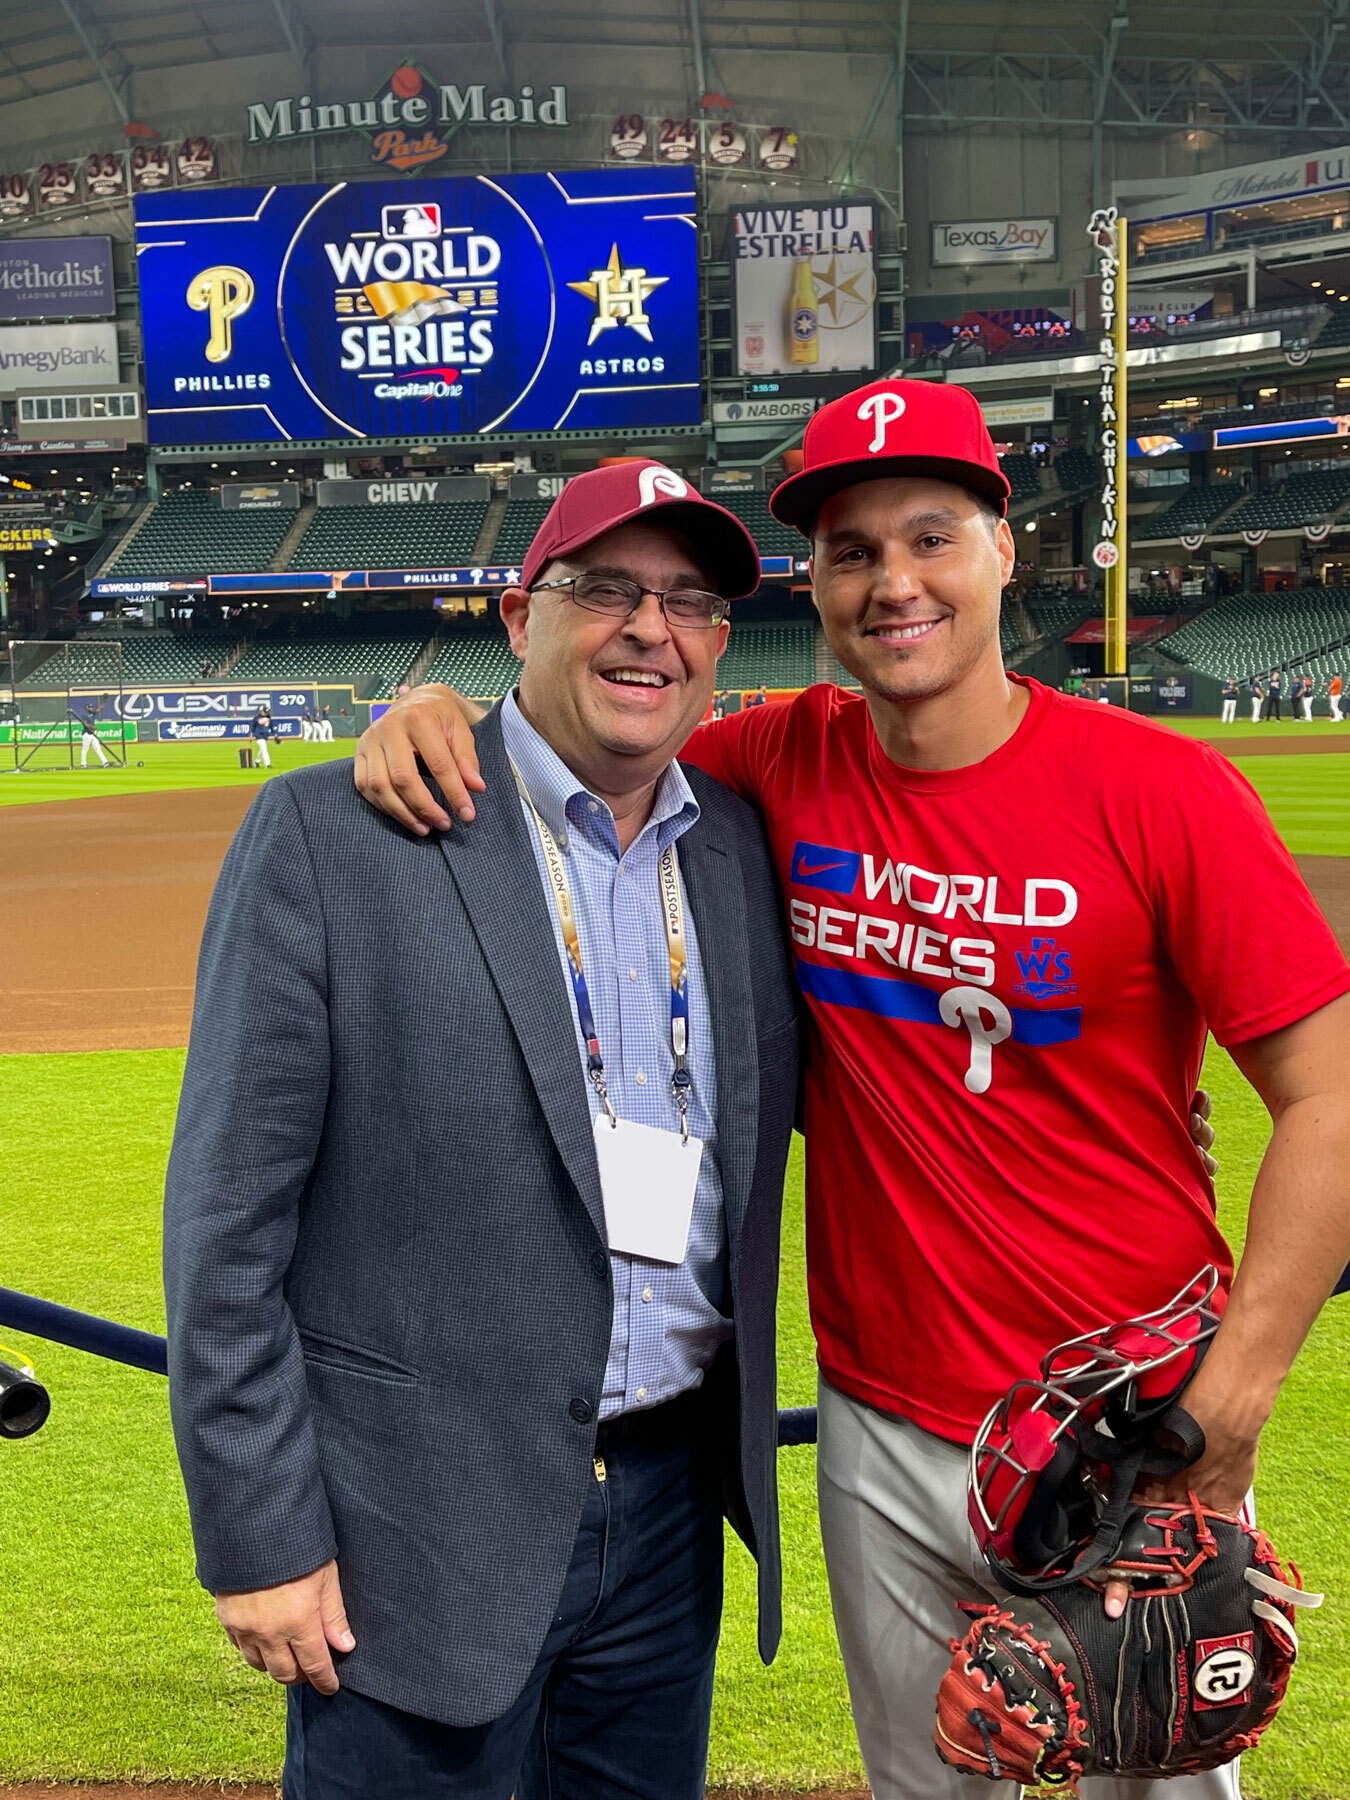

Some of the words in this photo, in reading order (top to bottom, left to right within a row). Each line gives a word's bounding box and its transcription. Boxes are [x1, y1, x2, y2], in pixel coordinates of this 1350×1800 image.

[247, 91, 429, 141] Minute
[439, 85, 569, 125] Maid
[612, 114, 644, 140] 49
[660, 117, 694, 144] 24
[719, 121, 735, 147] 5
[769, 126, 787, 153] 7
[132, 145, 168, 169] 34
[178, 136, 210, 162] 42
[371, 130, 448, 165] Park
[38, 163, 71, 188] 25
[86, 153, 118, 178] 33
[1324, 157, 1350, 181] U
[811, 207, 848, 230] TU
[940, 225, 998, 247] Texas
[1007, 223, 1048, 250] Bay
[0, 259, 29, 269] STON
[324, 235, 501, 284] WORLD
[17, 291, 56, 300] LEADING
[60, 289, 104, 298] MEDICINE
[1100, 258, 1116, 330] ROOT
[1166, 302, 1196, 311] CLUB
[186, 265, 254, 363] P
[340, 320, 494, 370] SERIES
[1100, 338, 1115, 358] 4
[580, 356, 665, 375] ASTROS
[174, 373, 271, 392] PHILLIES
[1100, 365, 1116, 422] THA
[746, 402, 811, 417] NABORS
[857, 392, 906, 453] P
[40, 440, 75, 451] Cantina
[367, 482, 438, 503] CHEVY
[1101, 429, 1117, 538] CHIKIN
[110, 582, 140, 592] WORLD
[142, 581, 170, 592] SERIES
[404, 572, 458, 583] PHILLIES
[157, 694, 271, 713] LEXUS
[279, 695, 305, 706] 370
[22, 729, 67, 740] National
[95, 728, 122, 738] ental
[278, 722, 293, 733] LIFE
[862, 853, 1078, 927] WORLD
[790, 899, 995, 987] SERIES
[1014, 951, 1072, 982] WS
[939, 985, 1012, 1094] P
[1208, 1659, 1242, 1693] 21
